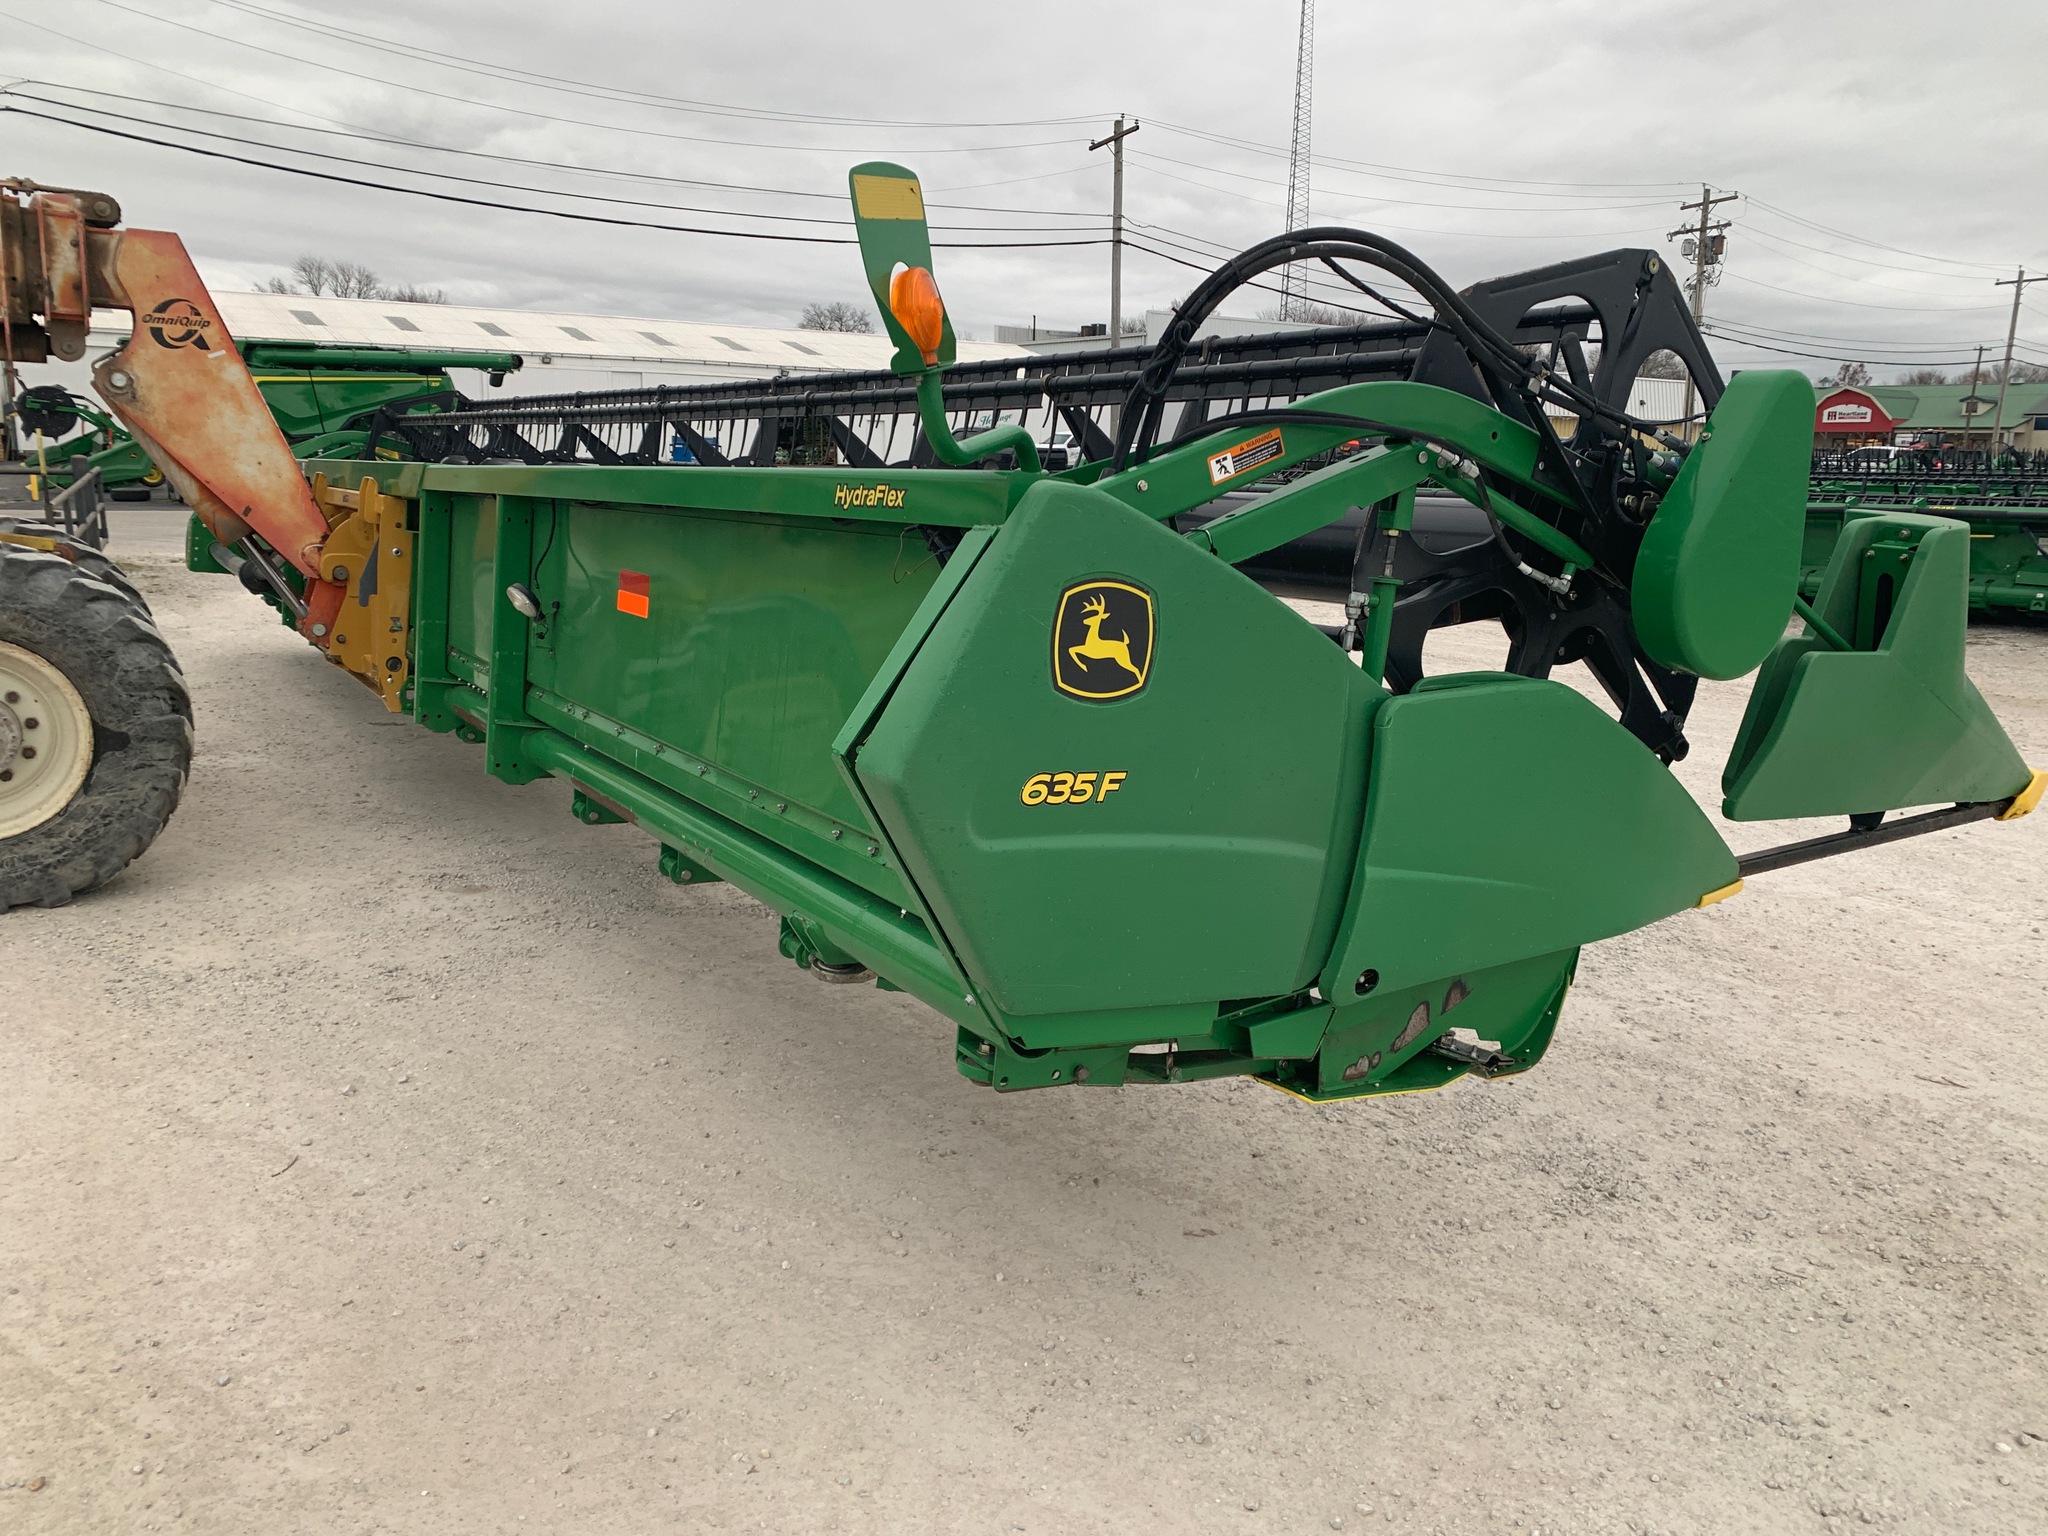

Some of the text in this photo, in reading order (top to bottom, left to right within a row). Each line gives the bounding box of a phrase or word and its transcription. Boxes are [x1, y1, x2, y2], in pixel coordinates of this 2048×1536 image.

[142, 314, 211, 329] OmniQuip
[1245, 432, 1273, 448] WARNING
[834, 483, 907, 510] HydraFlex
